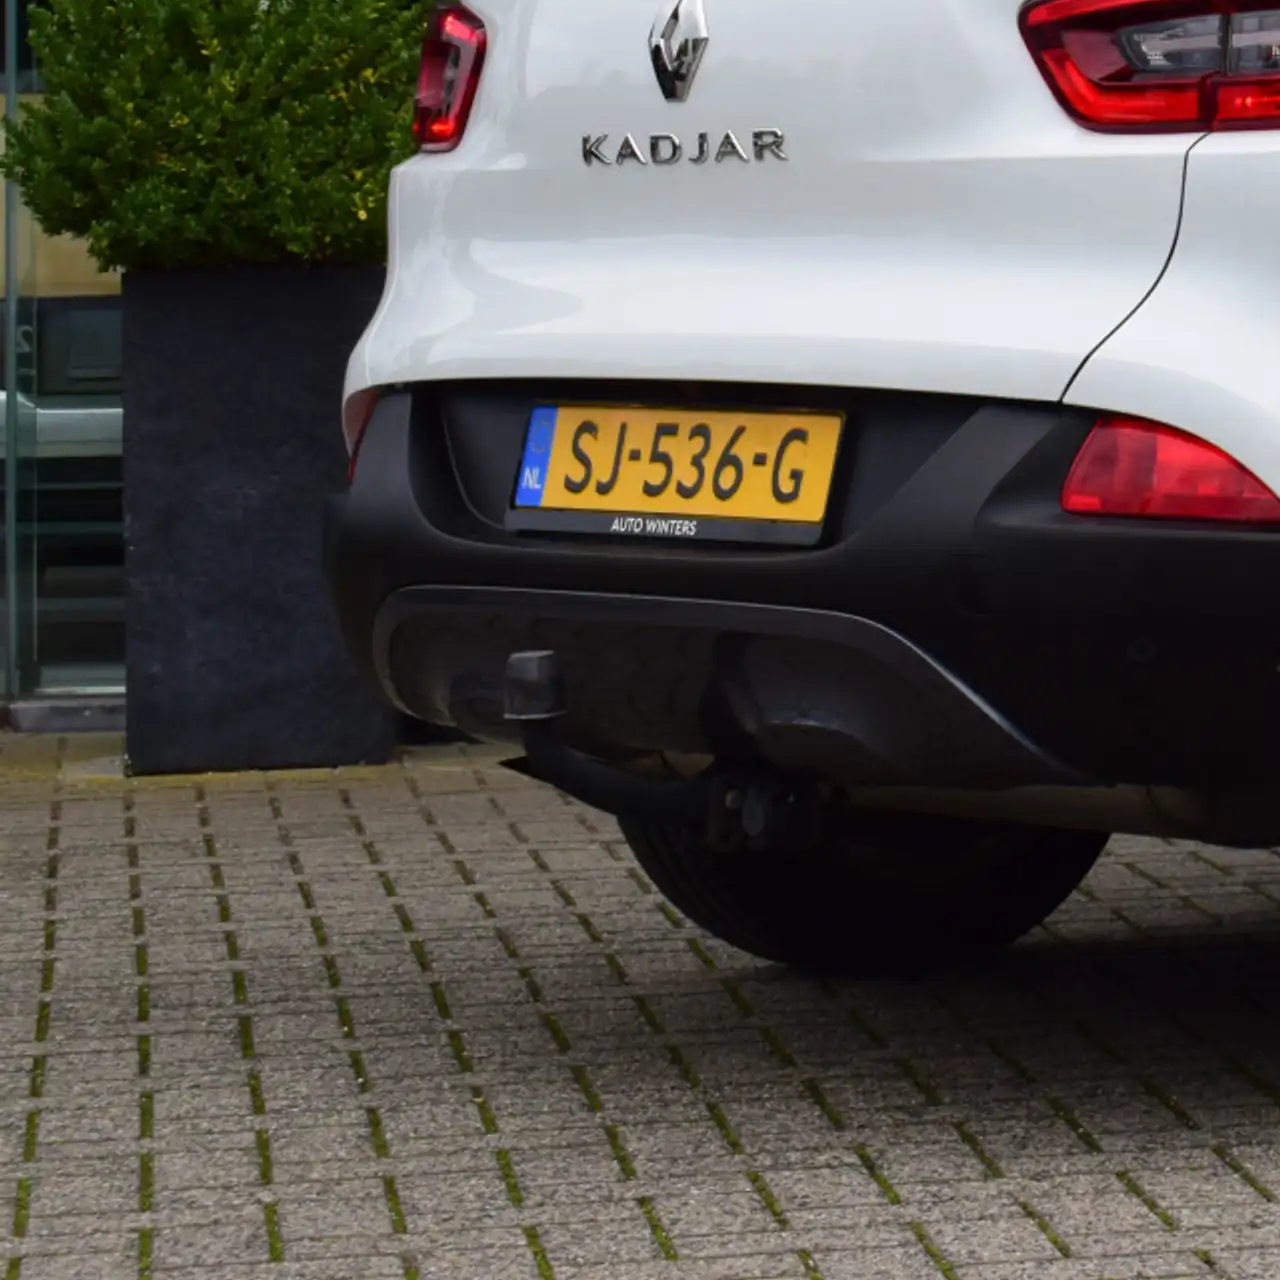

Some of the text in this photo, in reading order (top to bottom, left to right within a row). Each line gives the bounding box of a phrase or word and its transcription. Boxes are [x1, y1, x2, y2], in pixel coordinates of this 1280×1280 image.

[582, 127, 788, 167] KADJAR
[522, 419, 810, 504] NL SJ-536-G
[610, 516, 697, 537] AUTO WINTERS
